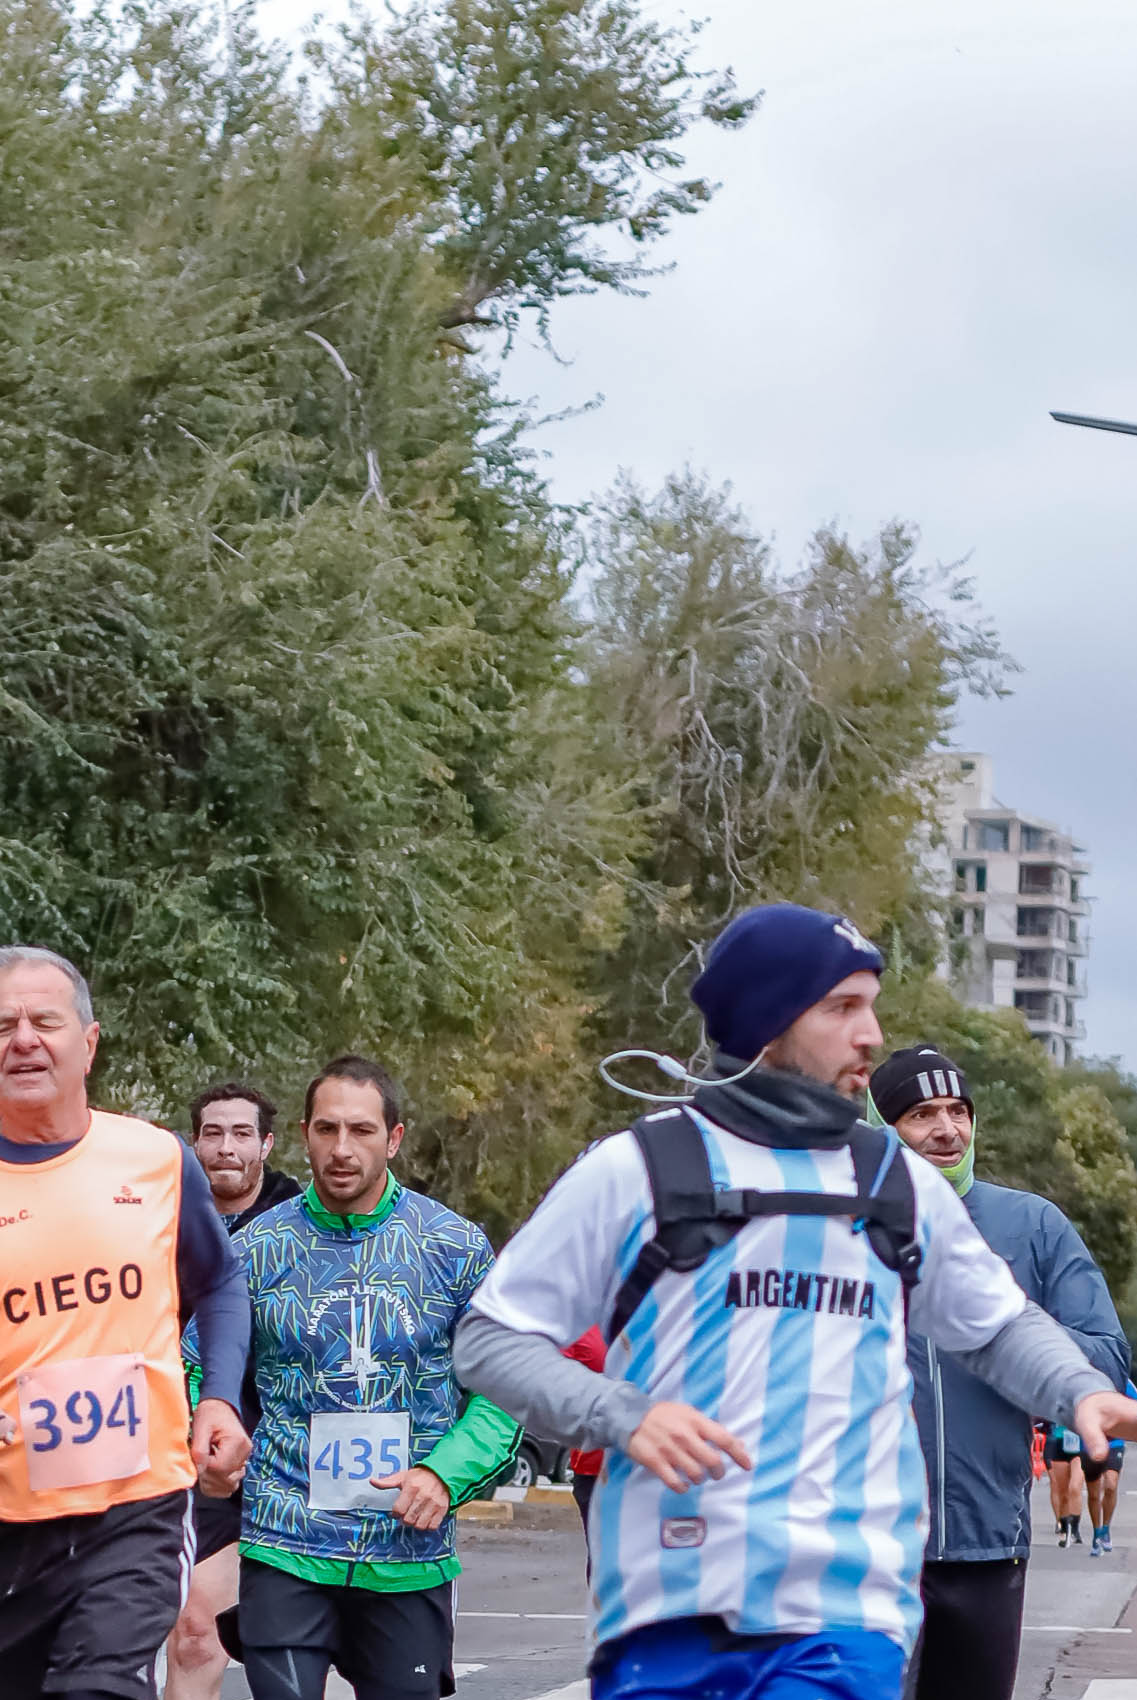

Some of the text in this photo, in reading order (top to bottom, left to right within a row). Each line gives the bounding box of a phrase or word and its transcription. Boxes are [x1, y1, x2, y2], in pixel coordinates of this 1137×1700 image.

[3, 1263, 143, 1324] CIEGO
[307, 1287, 349, 1336] MARATON
[378, 1289, 416, 1336] AUTISMO
[724, 1269, 875, 1320] ARGENTINA
[29, 1384, 142, 1453] 394
[313, 1438, 401, 1480] 435
